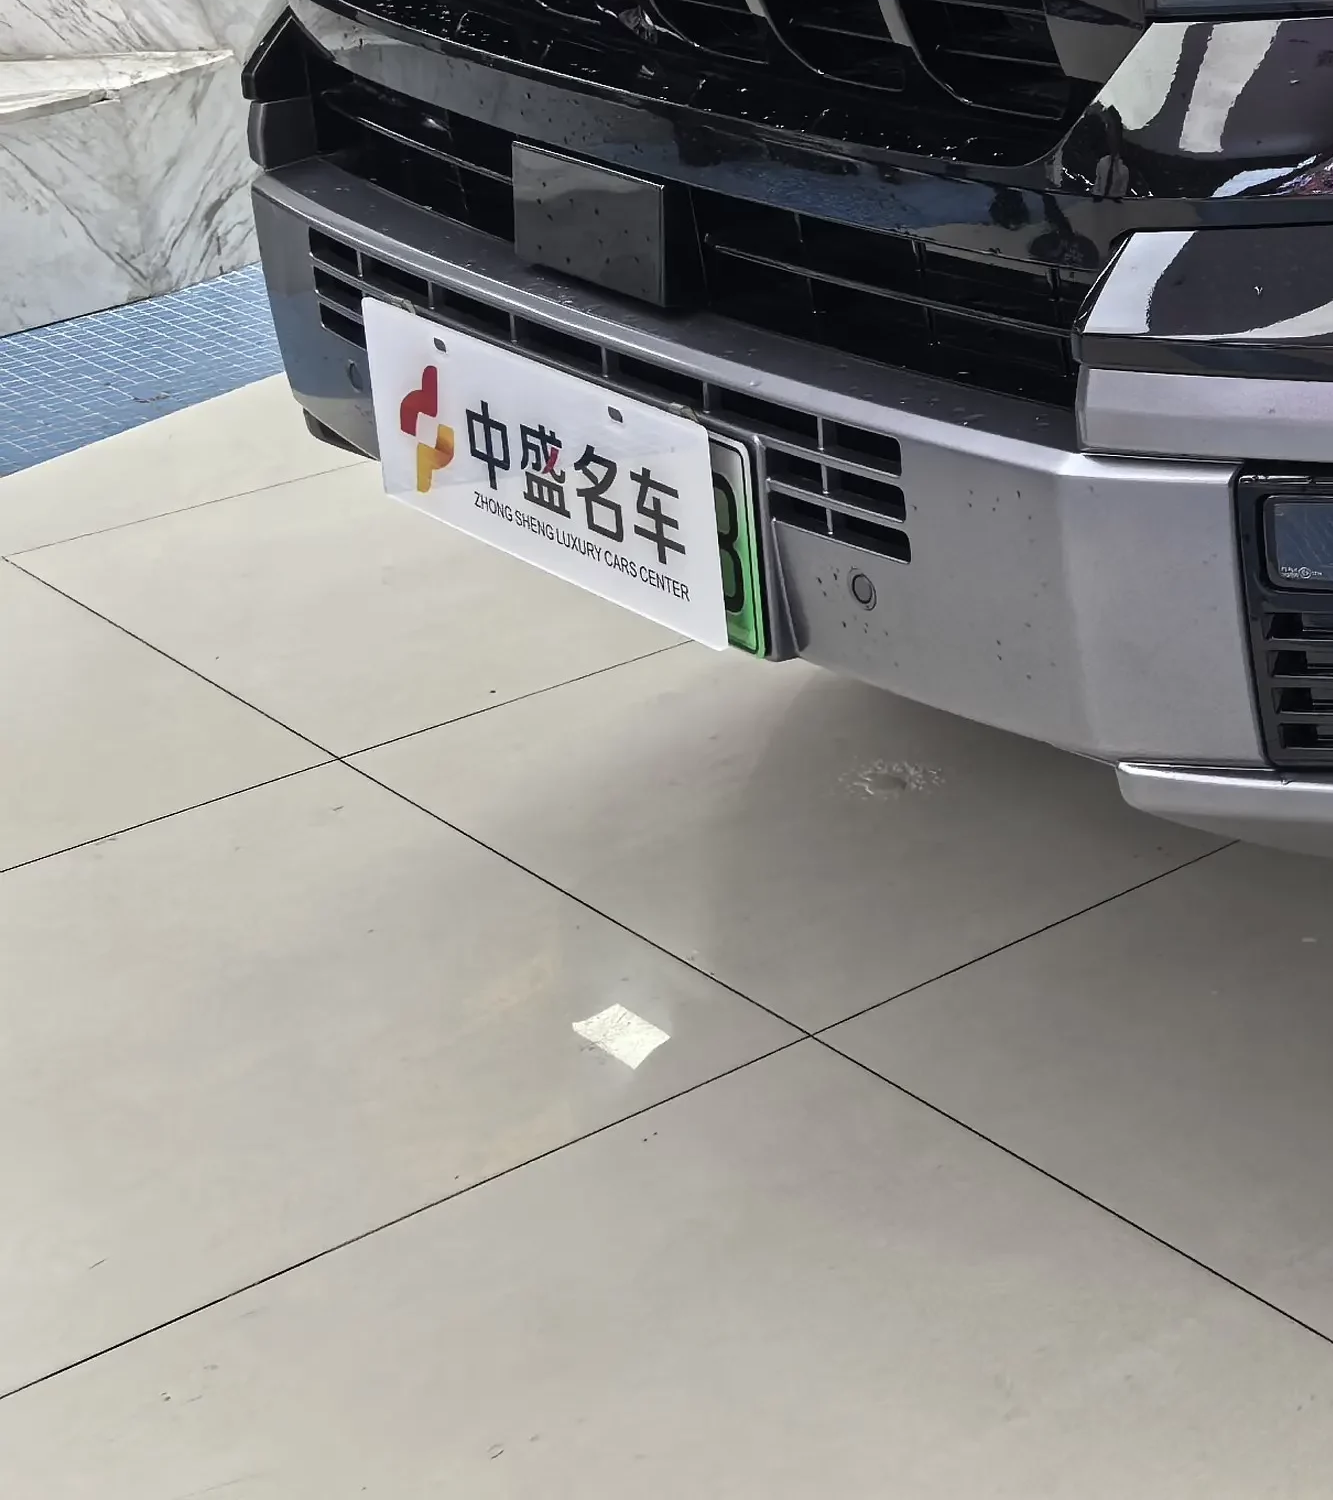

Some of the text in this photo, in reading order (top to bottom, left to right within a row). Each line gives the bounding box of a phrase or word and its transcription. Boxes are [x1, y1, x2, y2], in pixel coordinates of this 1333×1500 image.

[465, 399, 687, 565] 中盛名车
[473, 490, 691, 602] ZHONG SHENG LUXURY CARS CENTER
